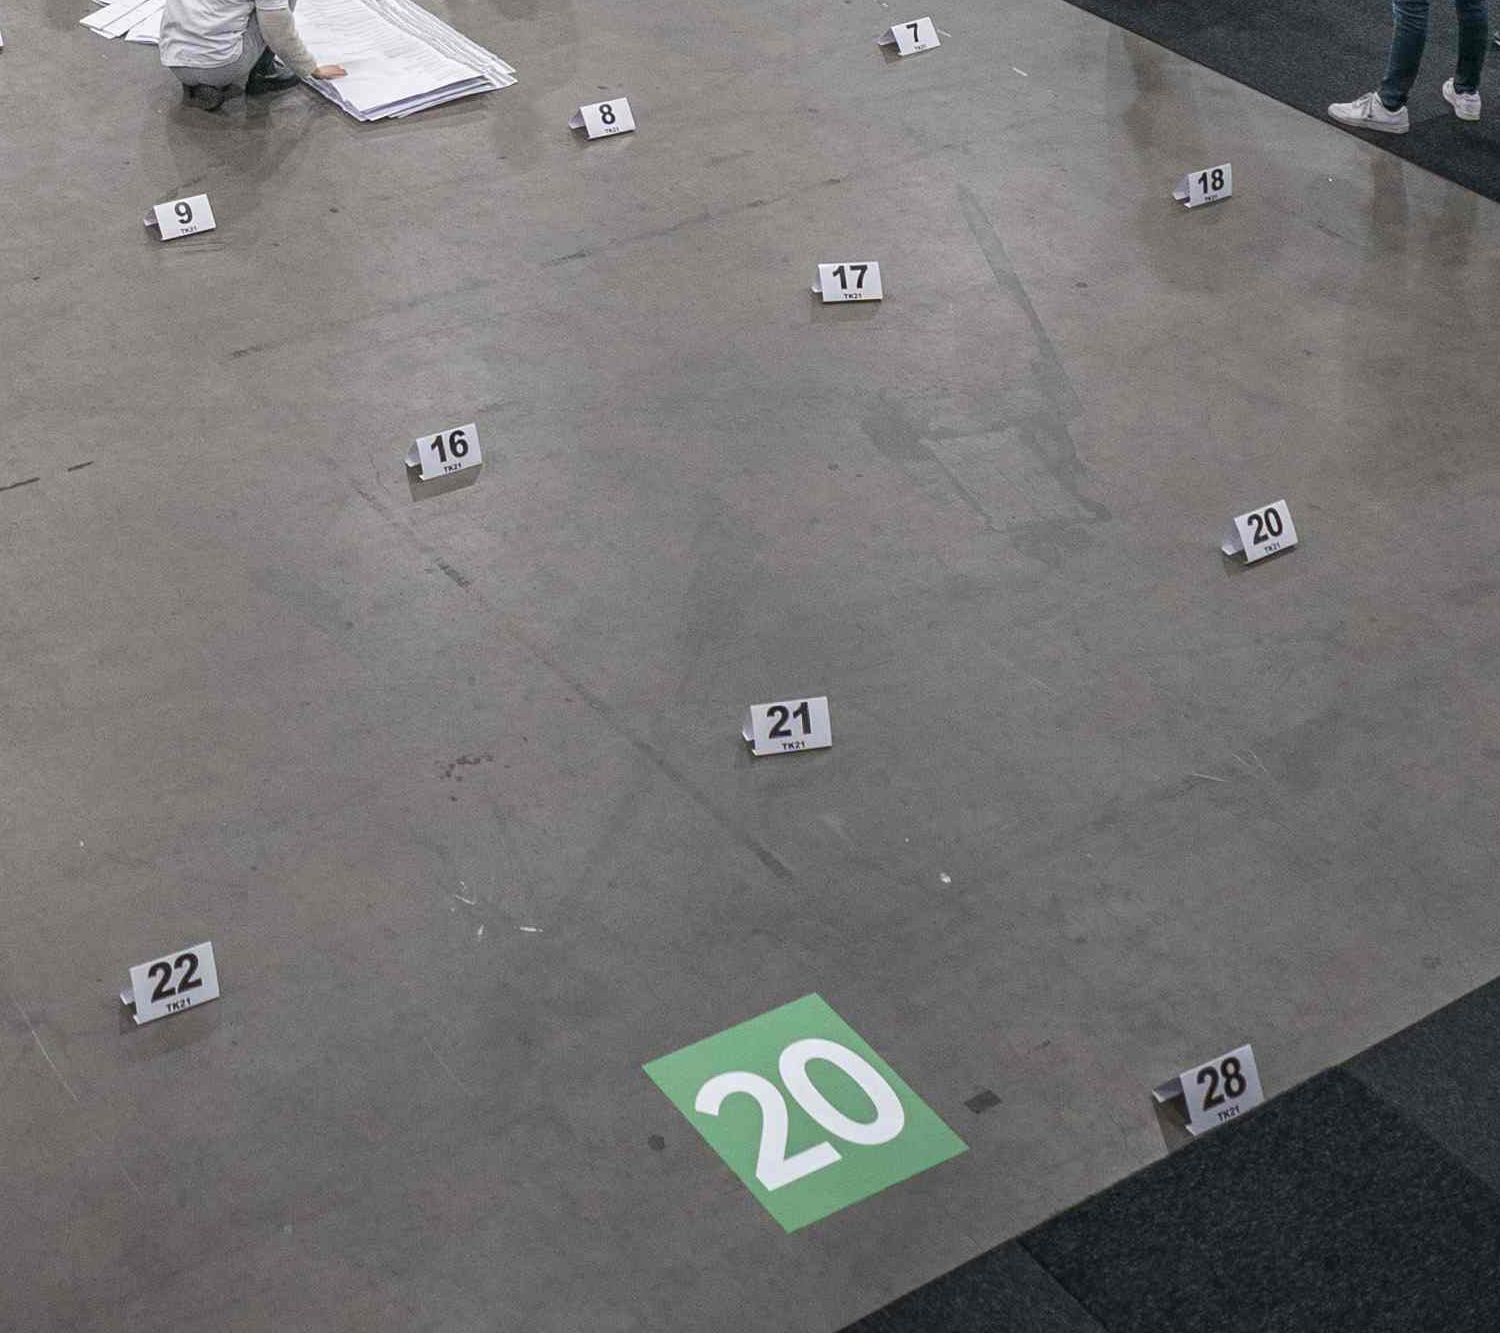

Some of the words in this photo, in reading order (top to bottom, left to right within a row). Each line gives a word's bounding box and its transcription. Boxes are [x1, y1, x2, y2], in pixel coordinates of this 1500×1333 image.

[906, 22, 918, 42] 7
[599, 104, 615, 125] 8
[1199, 169, 1224, 194] 18
[175, 202, 193, 225] 9
[833, 265, 867, 289] 17
[430, 430, 468, 461] 16
[444, 463, 461, 472] TK21
[1248, 508, 1282, 543] 20
[767, 702, 811, 739] 21
[783, 741, 804, 749] TK21
[148, 953, 202, 1005] 22
[167, 998, 190, 1011] TK21
[1196, 1056, 1246, 1106] 28
[694, 1038, 904, 1191] 20
[1218, 1106, 1239, 1119] TK21
